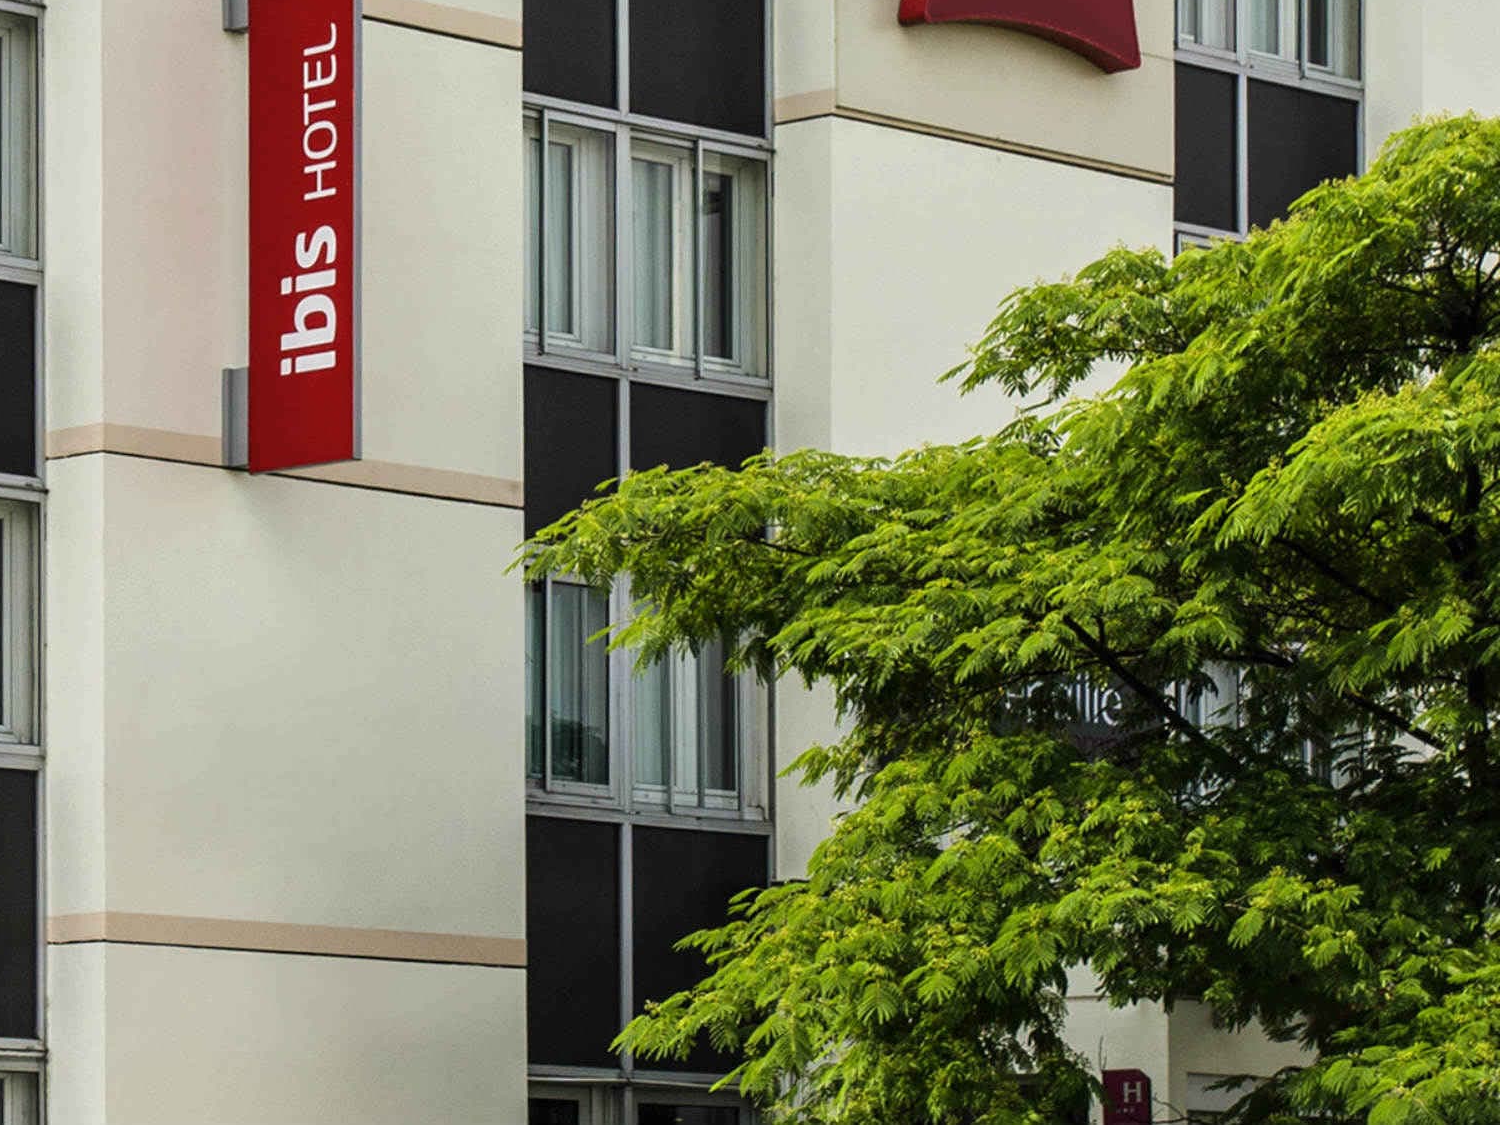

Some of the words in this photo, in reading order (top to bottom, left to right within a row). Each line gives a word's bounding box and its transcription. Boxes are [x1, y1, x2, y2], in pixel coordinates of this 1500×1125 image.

[303, 22, 338, 201] HOTEL
[280, 225, 337, 376] ibis
[1123, 1081, 1142, 1103] H
